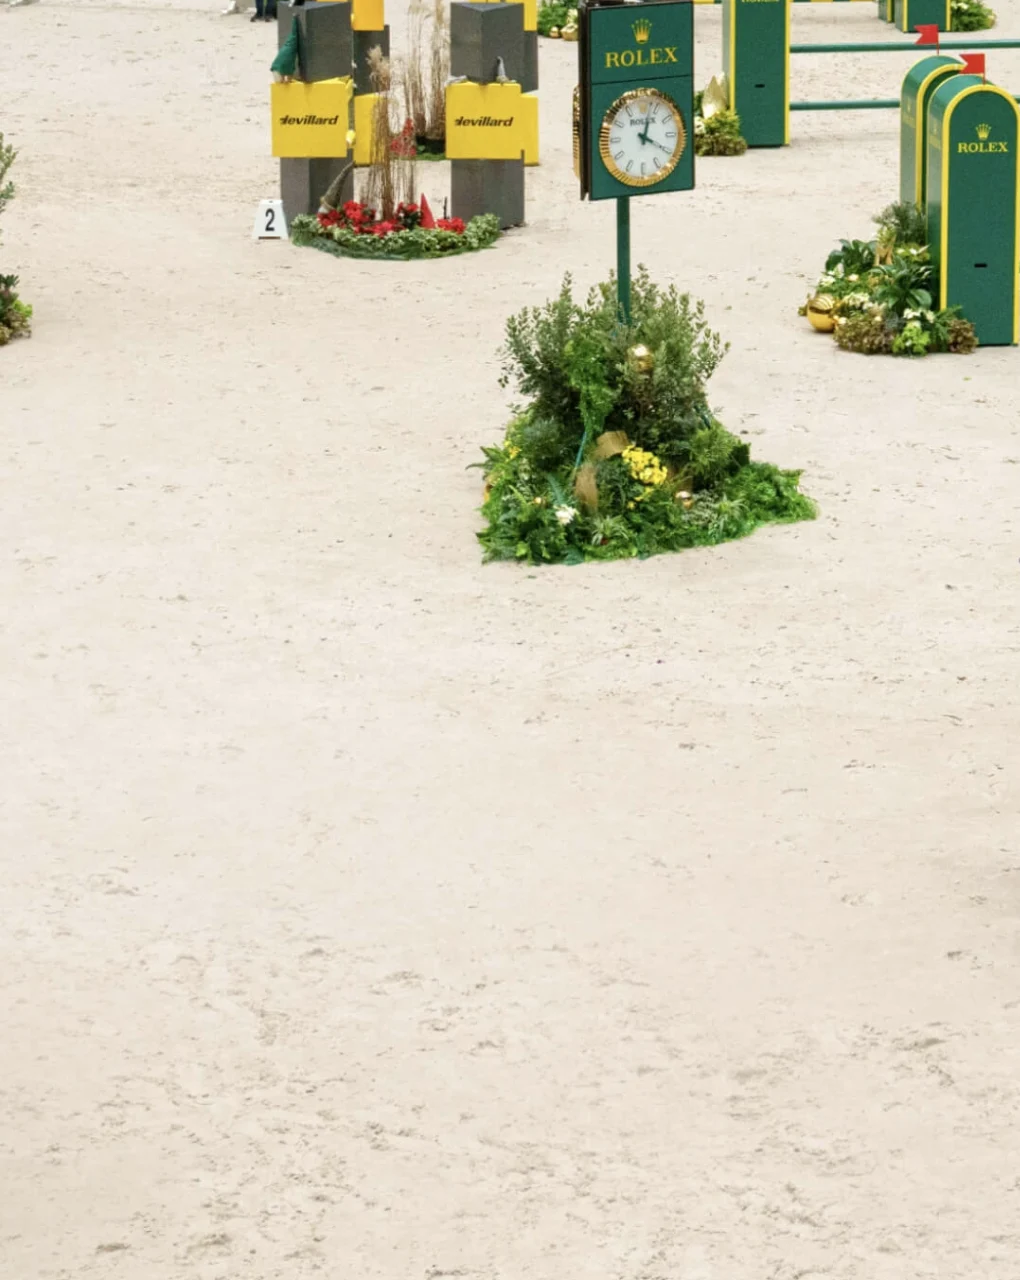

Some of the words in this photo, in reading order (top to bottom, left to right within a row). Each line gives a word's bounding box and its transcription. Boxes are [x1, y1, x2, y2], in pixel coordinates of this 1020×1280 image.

[605, 46, 678, 68] ROLEX
[280, 114, 339, 126] devillard
[454, 116, 514, 128] devillard
[957, 141, 1008, 153] ROLEX
[265, 208, 275, 232] 2
